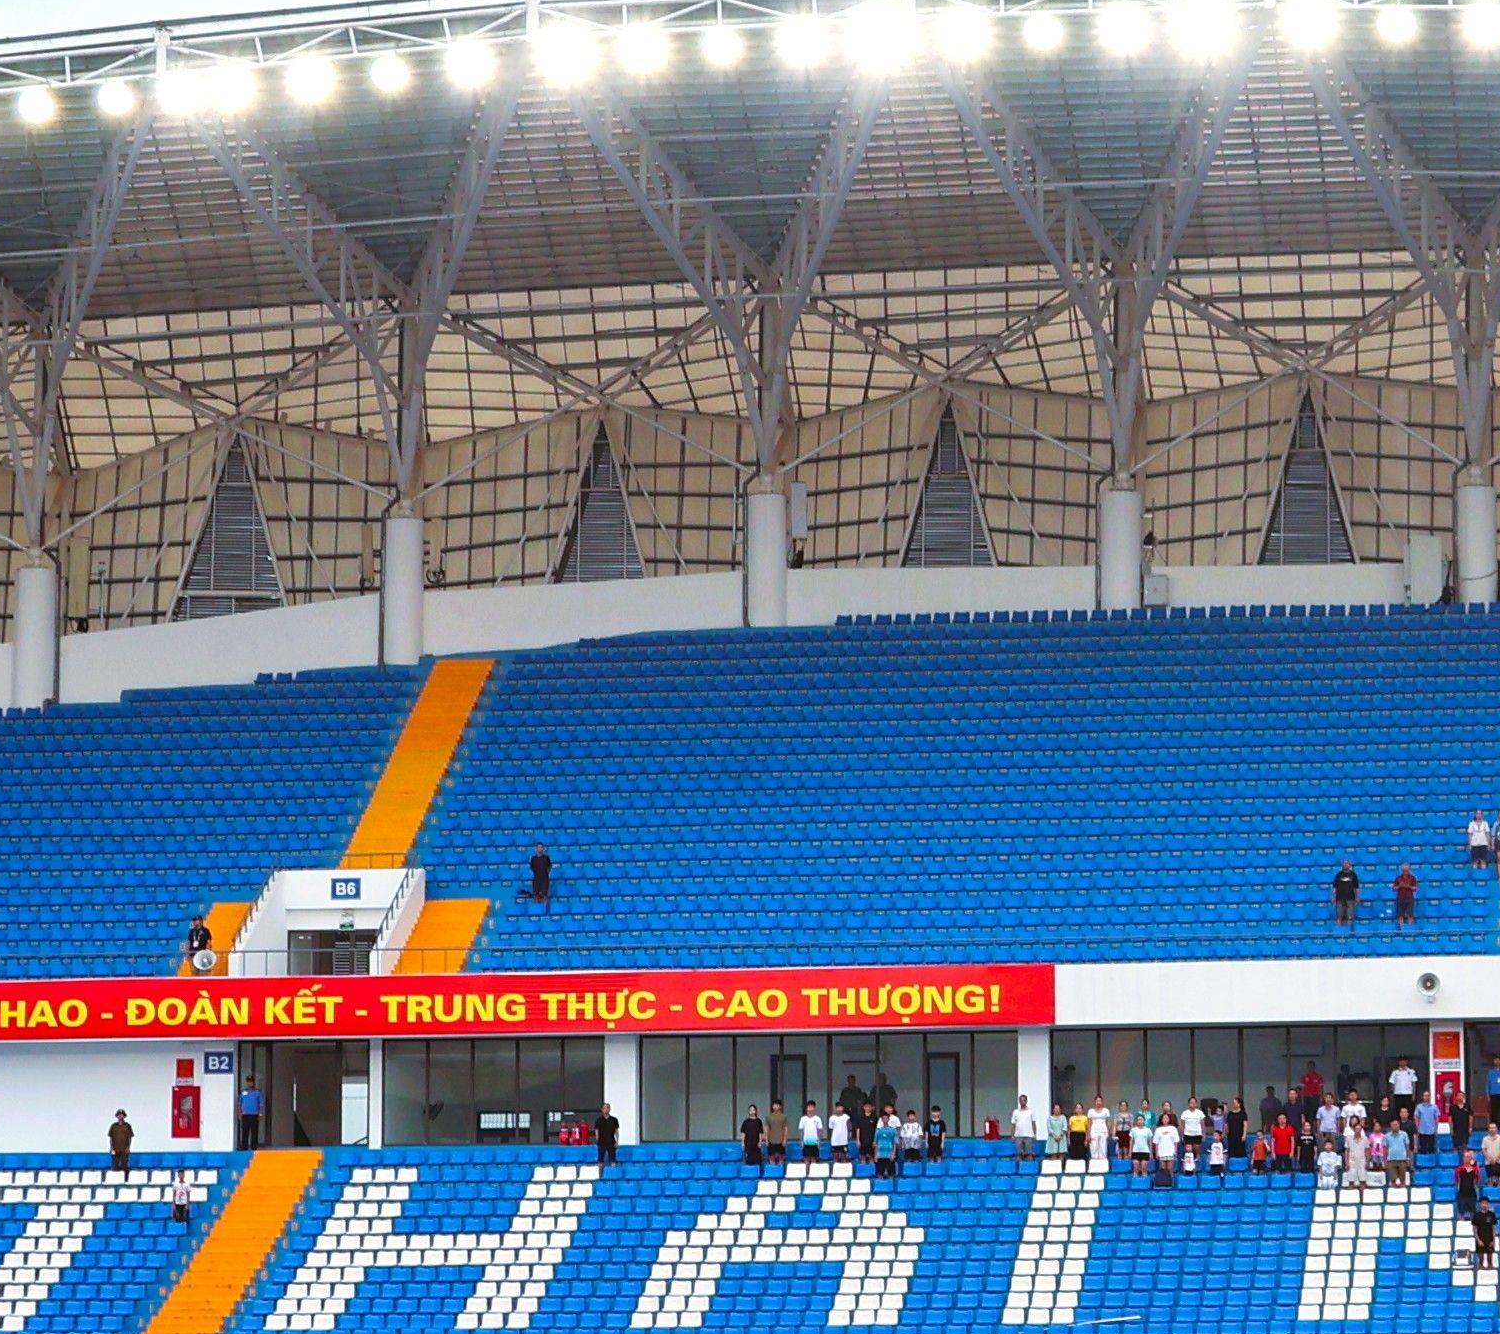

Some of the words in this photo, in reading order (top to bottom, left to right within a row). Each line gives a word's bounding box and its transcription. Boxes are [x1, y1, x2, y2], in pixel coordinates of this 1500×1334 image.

[336, 882, 355, 895] B6
[126, 991, 248, 1025] ĐOÀN
[265, 985, 342, 1023] KẾT
[381, 994, 525, 1022] TRUNG
[540, 989, 655, 1028] THỰC
[697, 990, 787, 1018] CAO
[802, 984, 999, 1023] THƯỢNG!
[209, 1057, 228, 1069] B2
